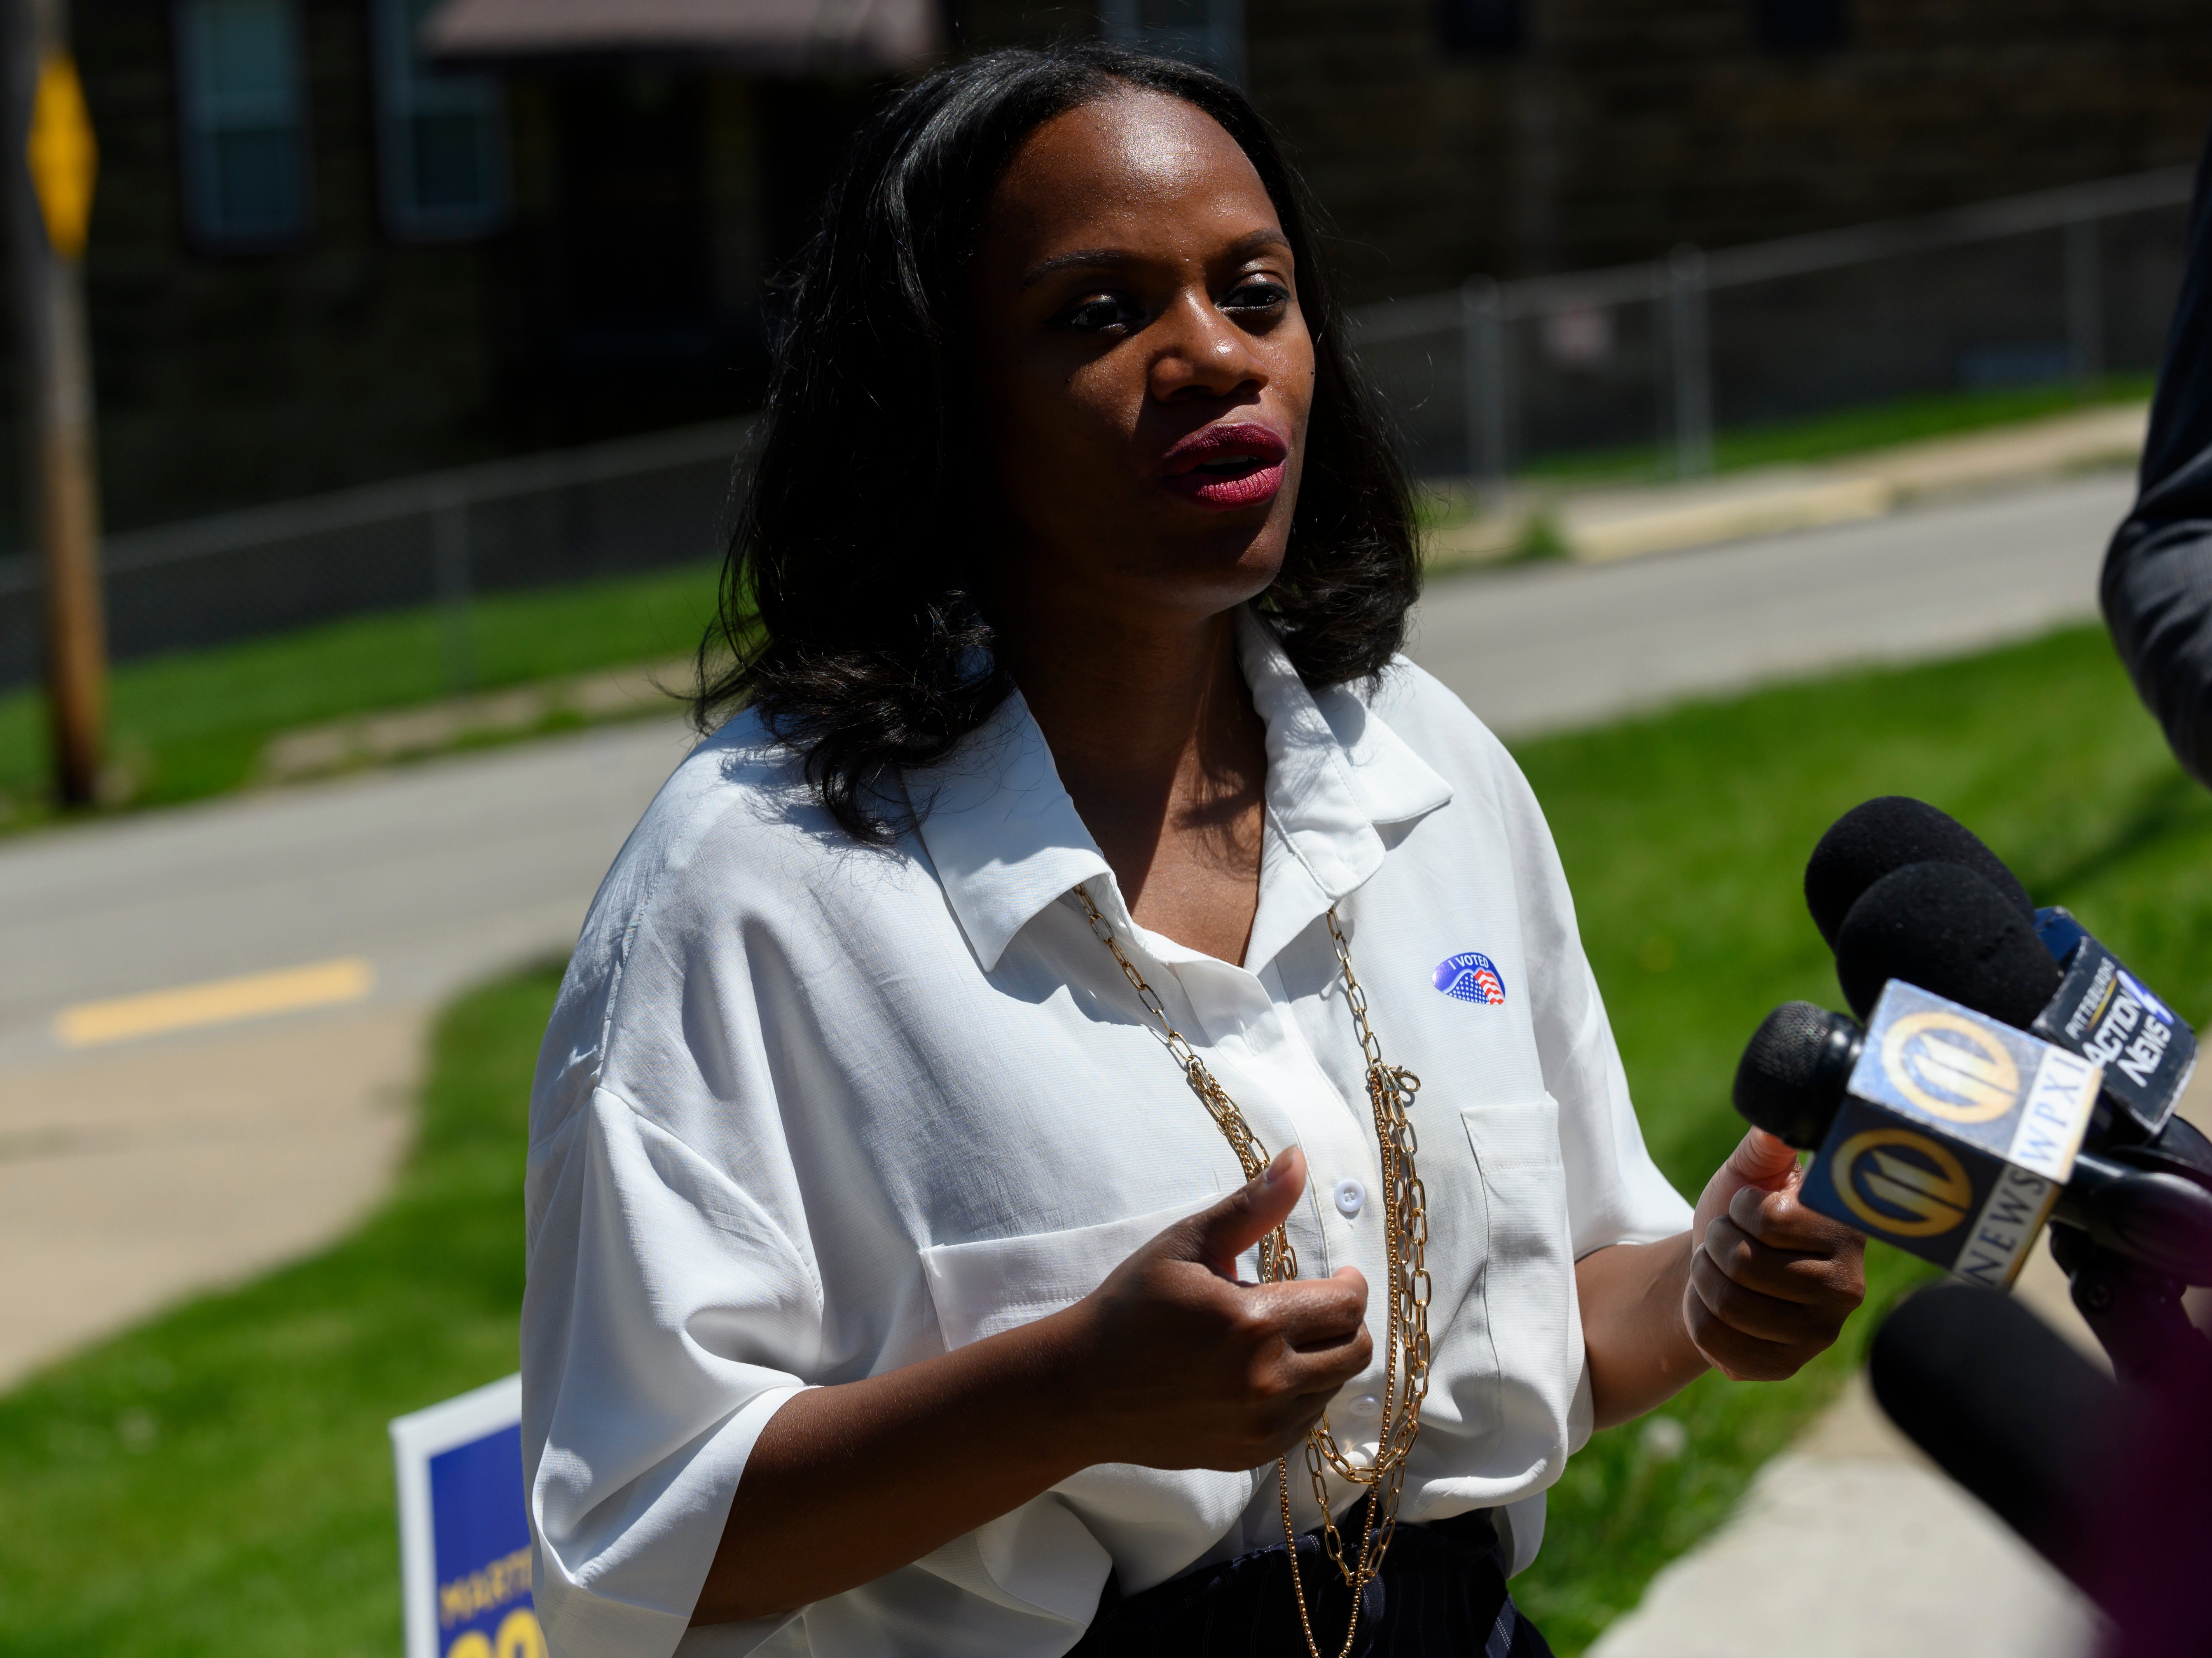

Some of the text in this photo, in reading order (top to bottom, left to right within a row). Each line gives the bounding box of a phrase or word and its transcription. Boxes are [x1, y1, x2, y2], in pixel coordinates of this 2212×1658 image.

[1448, 954, 1489, 970] I VOTED
[2082, 988, 2142, 1069] ACTION
[2117, 1014, 2171, 1088] NEWS
[2020, 1055, 2085, 1162] WPXI
[1962, 1169, 2047, 1286] NEWS
